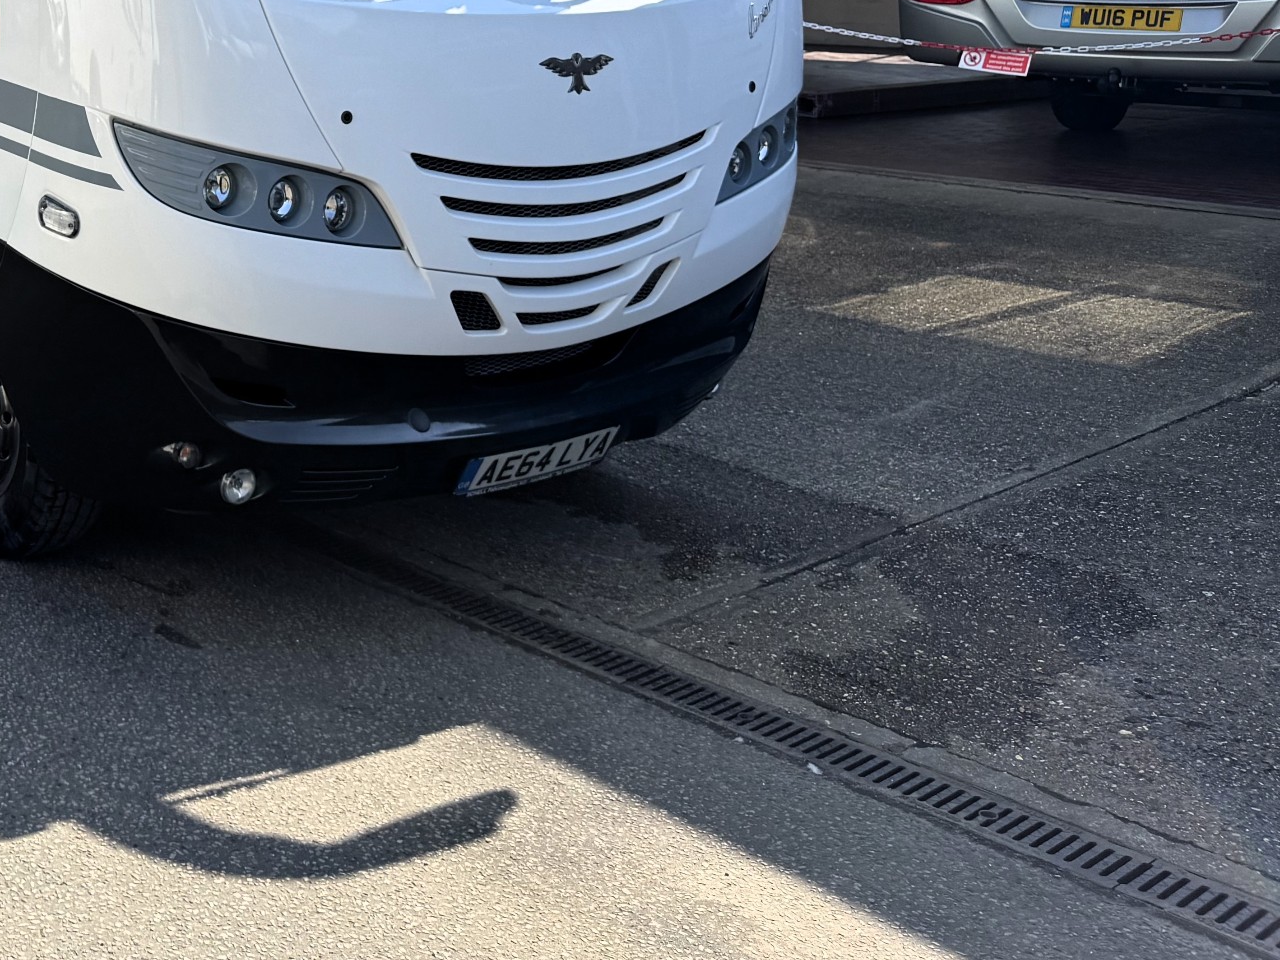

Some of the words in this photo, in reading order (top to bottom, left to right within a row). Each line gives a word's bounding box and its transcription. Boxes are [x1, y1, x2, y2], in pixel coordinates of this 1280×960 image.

[1080, 8, 1126, 26] WU16
[1131, 9, 1175, 28] PUF
[475, 446, 556, 487] AE64
[556, 431, 611, 468] LYA
